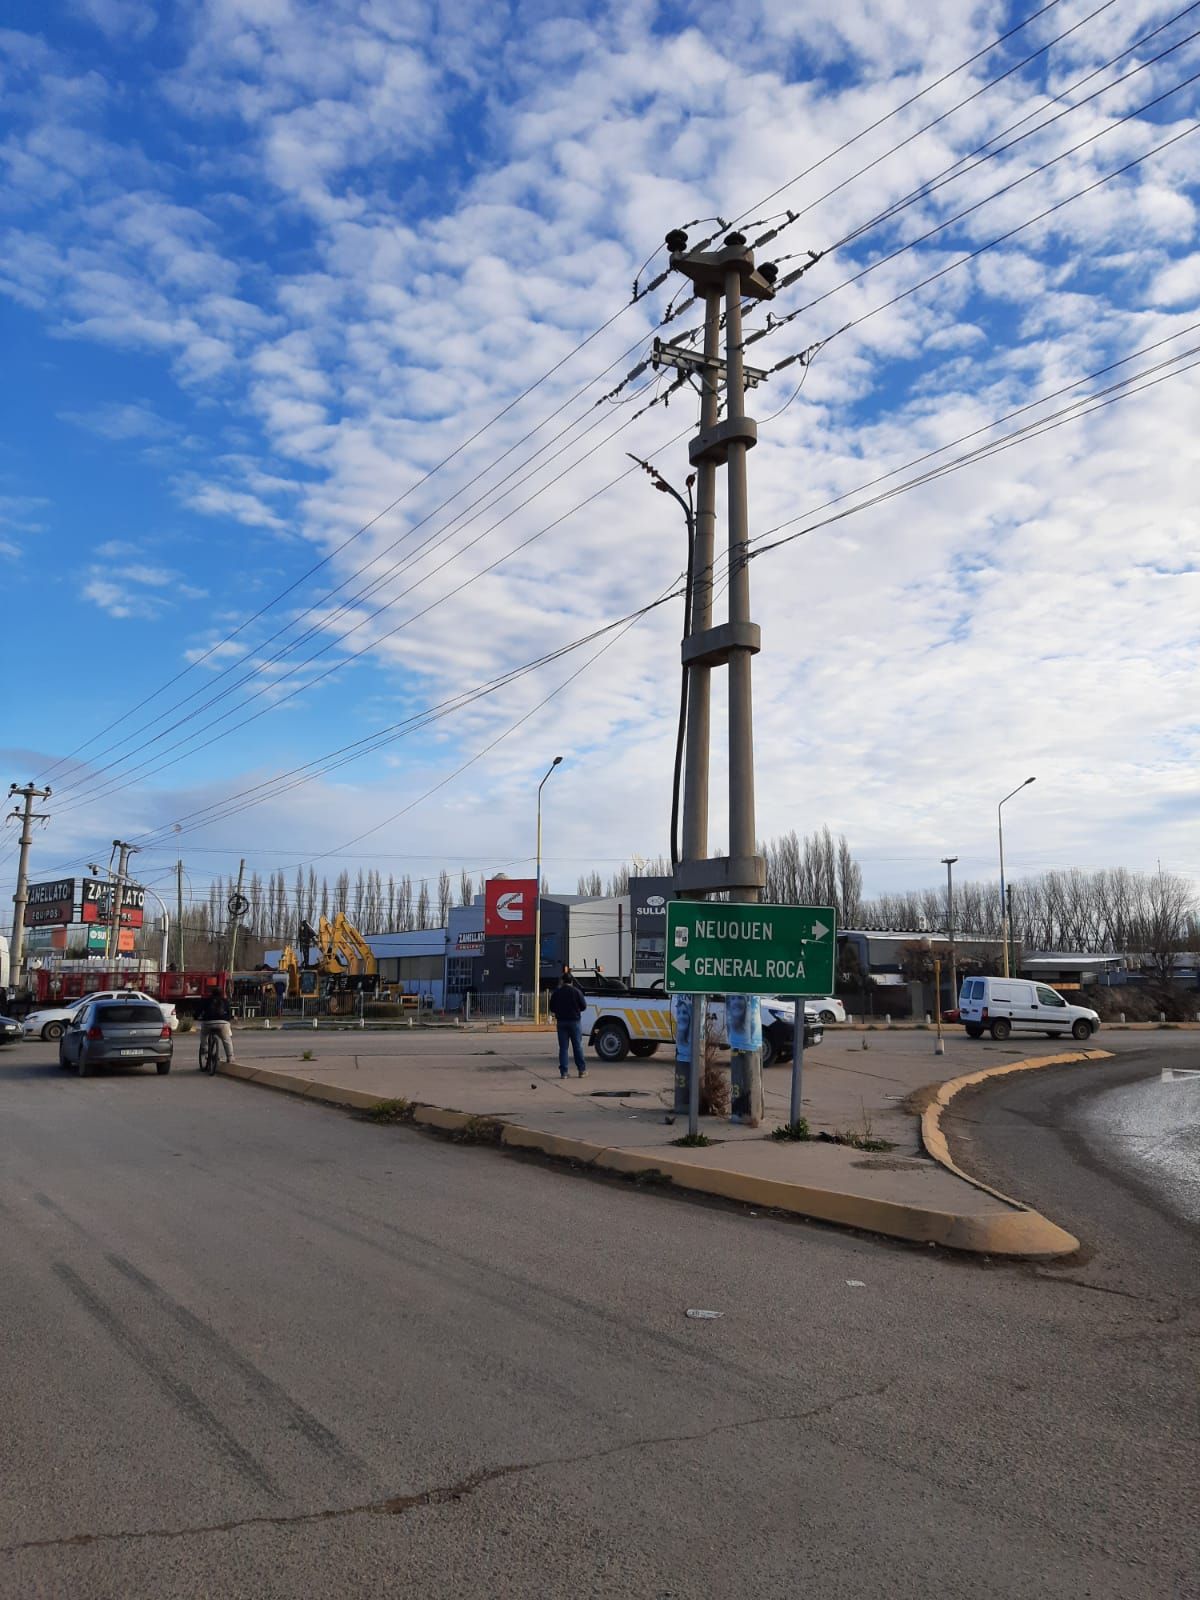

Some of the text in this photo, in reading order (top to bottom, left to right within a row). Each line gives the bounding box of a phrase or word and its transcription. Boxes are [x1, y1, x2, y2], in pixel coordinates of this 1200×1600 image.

[27, 883, 68, 904] ANELLATO
[87, 883, 145, 907] ZAEATO
[695, 920, 773, 940] NEUQUEN
[694, 957, 806, 979] GENERAL ROCA
